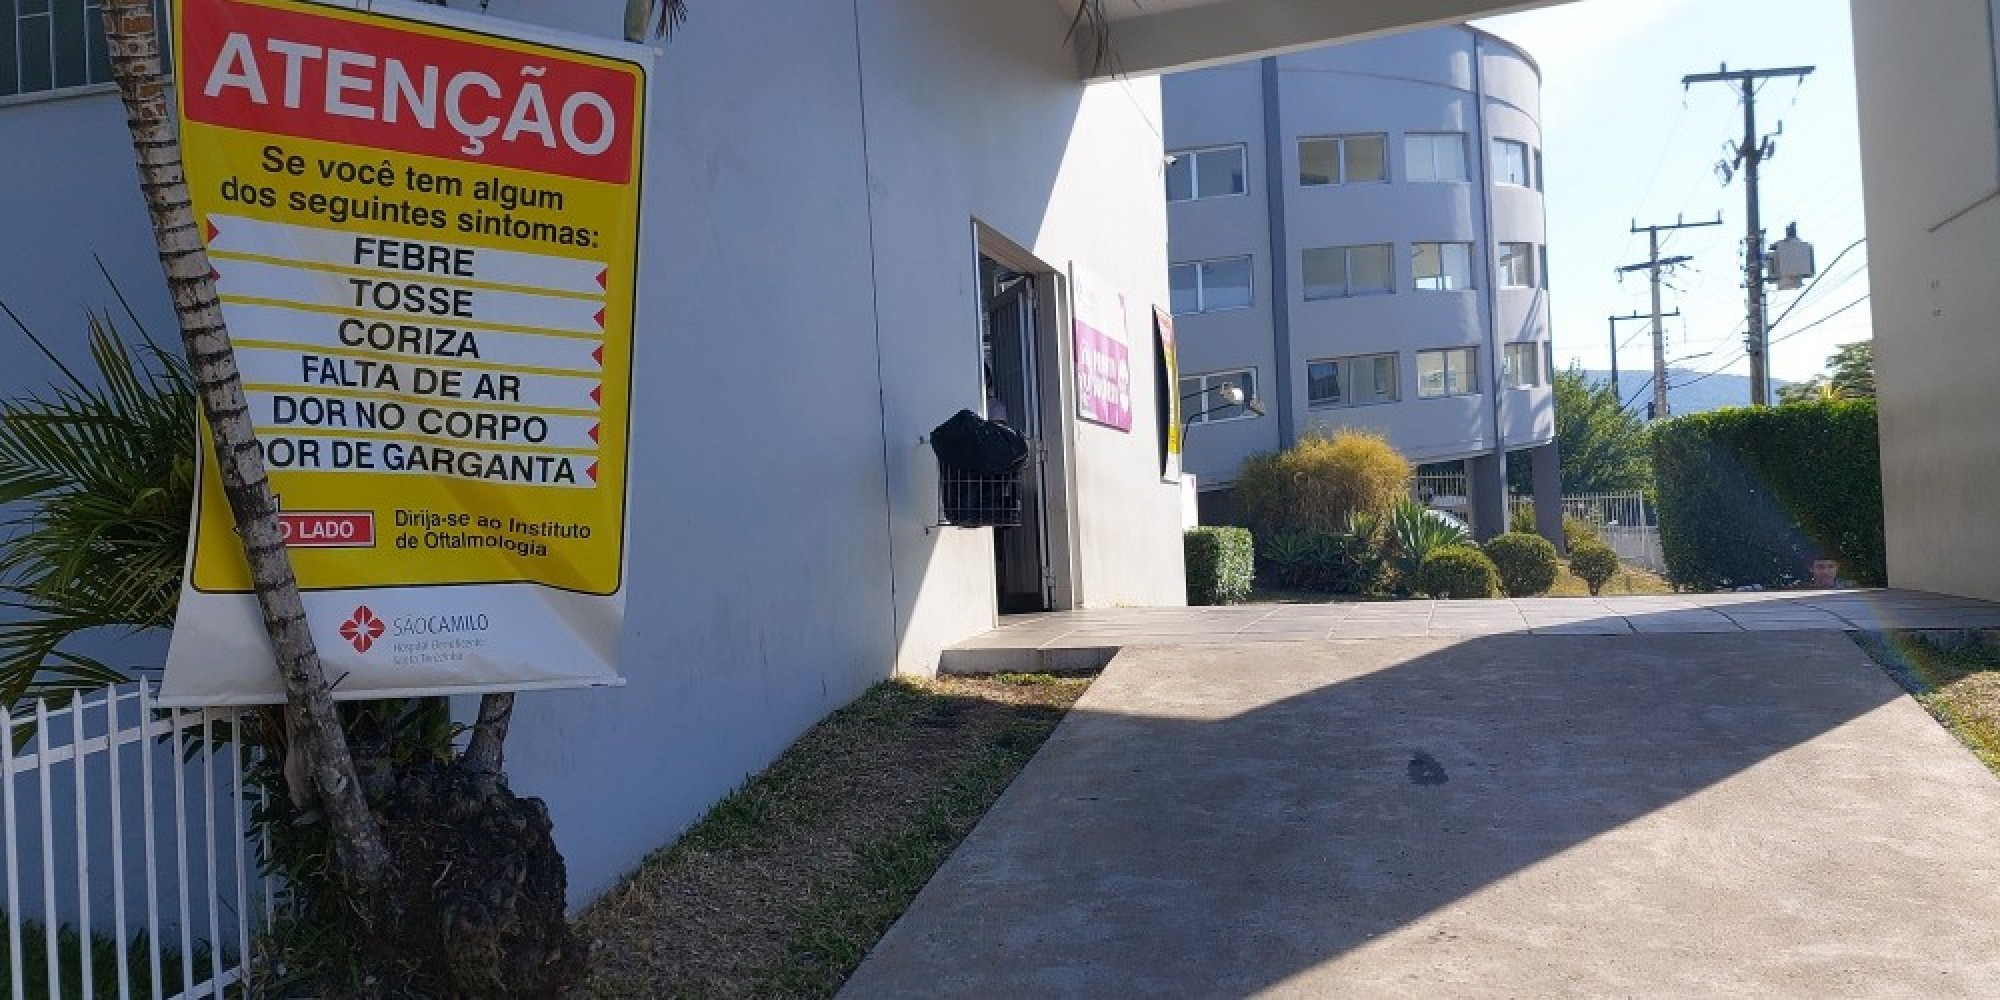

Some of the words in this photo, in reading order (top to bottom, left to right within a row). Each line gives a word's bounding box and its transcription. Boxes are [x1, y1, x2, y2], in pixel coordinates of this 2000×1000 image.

[204, 32, 615, 156] ATENÇÃO
[261, 145, 305, 176] Se
[318, 157, 396, 187] você
[406, 165, 462, 197] tem
[473, 178, 564, 211] algum
[221, 177, 276, 207] dos
[288, 190, 446, 229] seguintes
[457, 201, 599, 248] sintomas:
[354, 237, 474, 276] FEBRE
[350, 278, 473, 318] TOSSE
[338, 318, 479, 358] CORIZA
[302, 355, 399, 391] FALTA
[413, 368, 463, 398] DE
[473, 374, 520, 402] AR
[273, 395, 347, 426] DOR
[356, 402, 405, 430] NO
[418, 408, 547, 443] CORPO
[332, 440, 374, 469] DE
[383, 443, 575, 484] GARGANTA
[299, 521, 354, 538] LADO
[395, 510, 470, 530] Dirija-se
[477, 515, 502, 529] ao
[509, 517, 591, 539] Instituto
[395, 532, 418, 549] de
[424, 532, 547, 557] Oftalmologia
